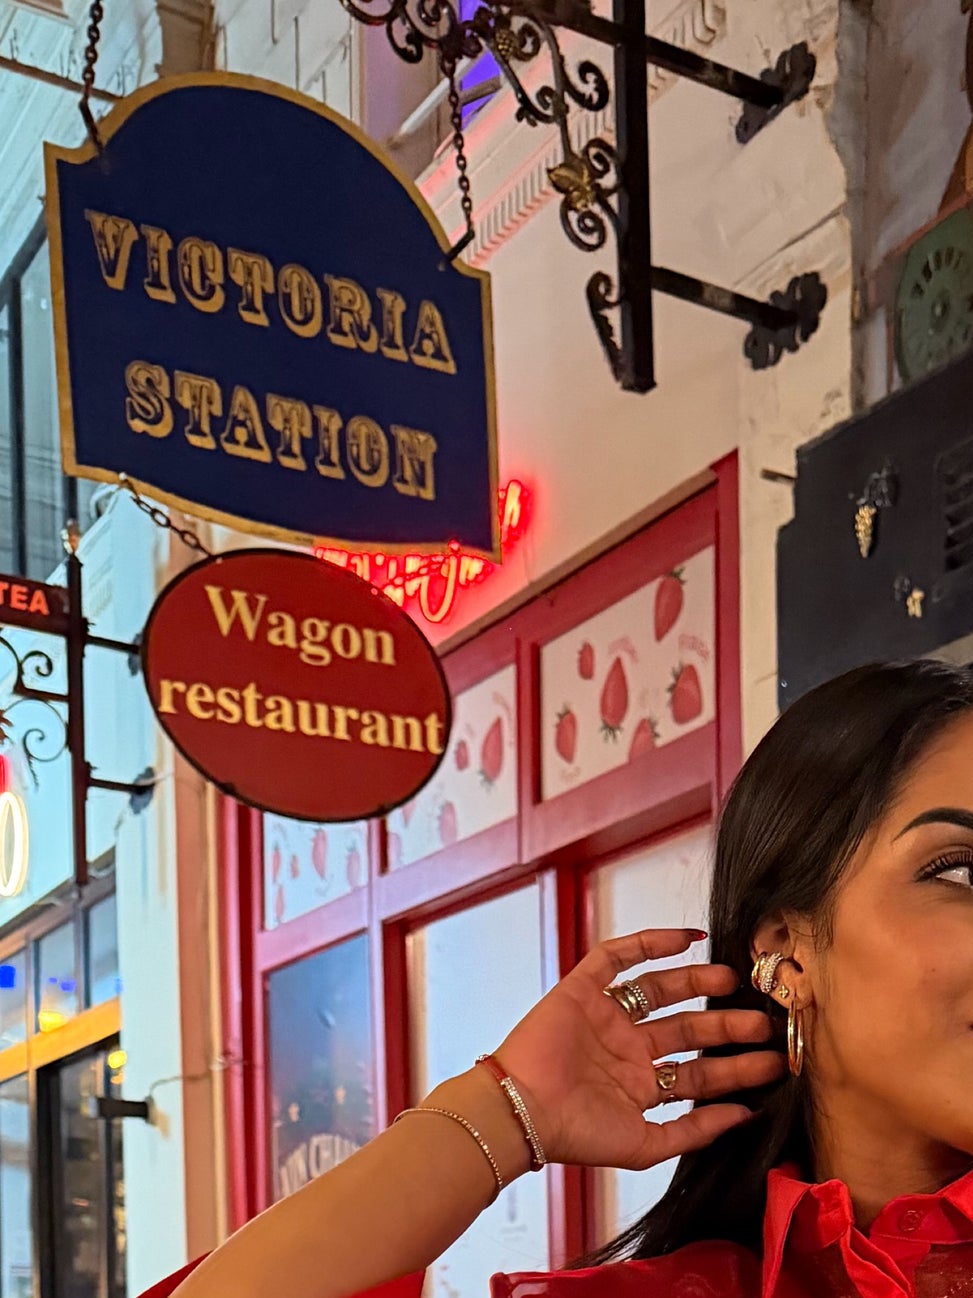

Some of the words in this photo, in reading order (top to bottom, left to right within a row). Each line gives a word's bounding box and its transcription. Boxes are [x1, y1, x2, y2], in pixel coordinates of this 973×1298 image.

[85, 209, 457, 375] VICTORIA
[125, 360, 438, 501] STATION
[0, 581, 50, 616] TEA
[204, 584, 396, 666] Wagon
[158, 678, 446, 755] restaurant
